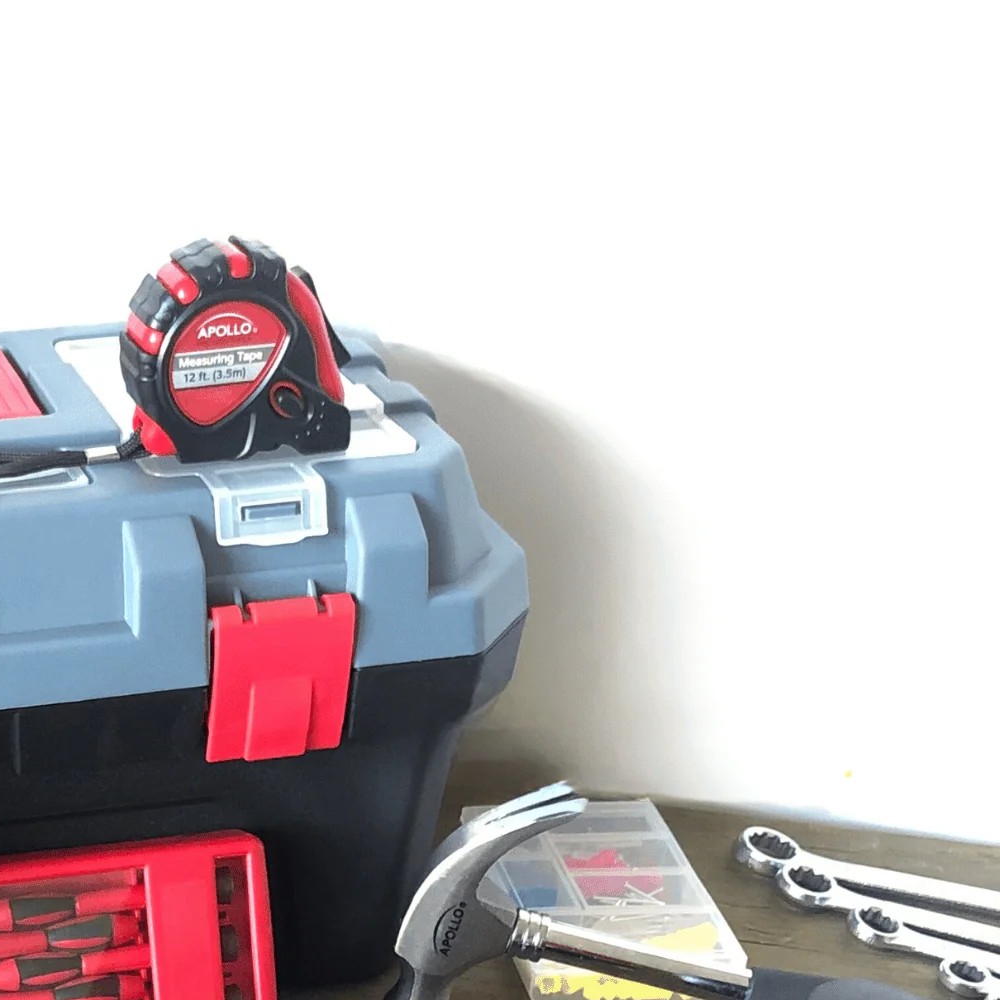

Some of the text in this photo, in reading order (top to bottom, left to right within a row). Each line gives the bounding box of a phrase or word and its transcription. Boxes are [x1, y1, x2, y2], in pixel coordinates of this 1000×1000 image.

[197, 322, 252, 339] APOLLO
[178, 351, 263, 368] Measuring Tape
[184, 367, 247, 383] 12 ft. (3.5m)
[439, 908, 465, 957] APOLLO
